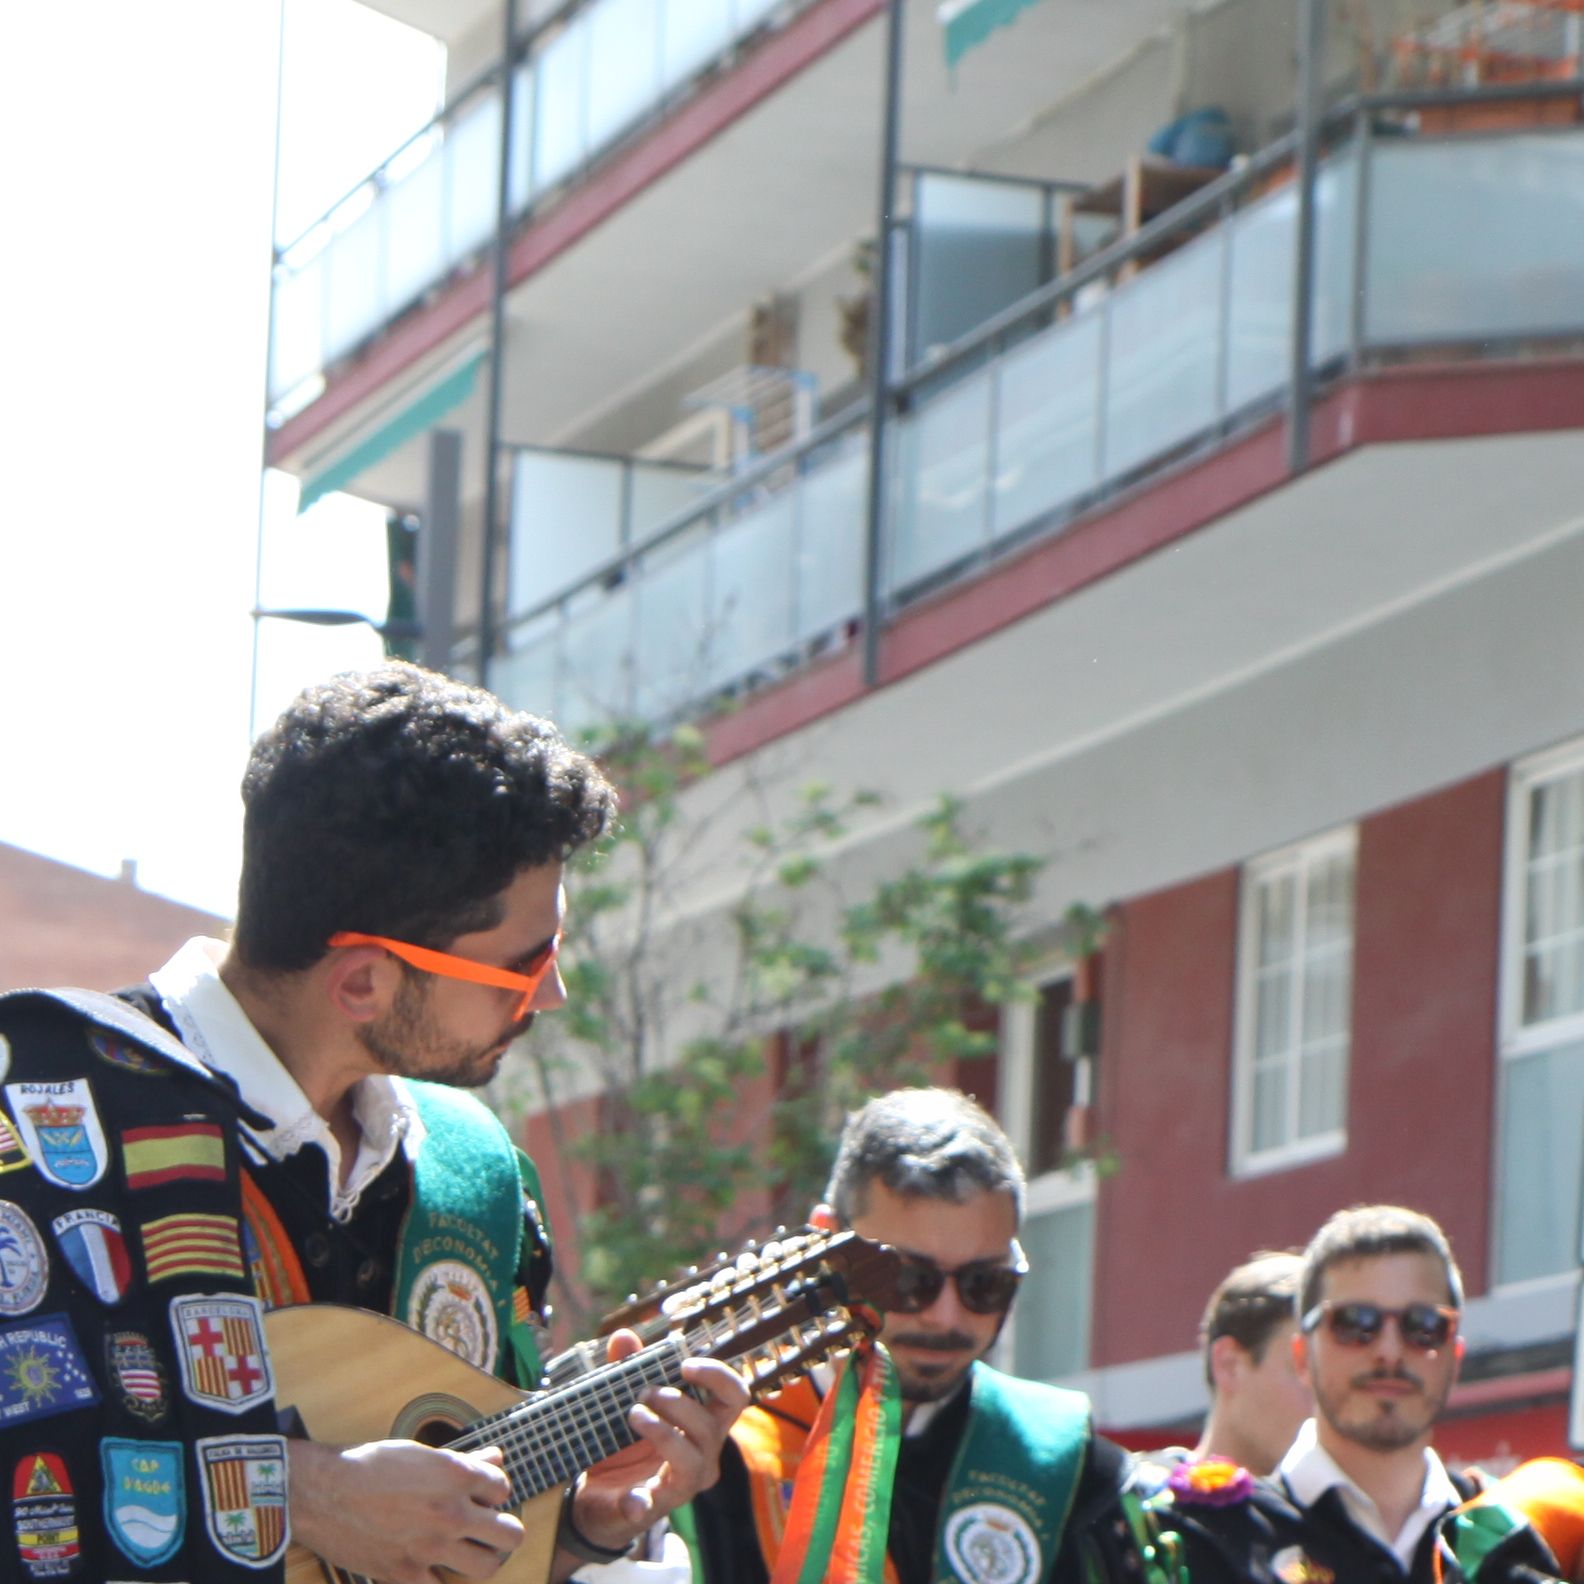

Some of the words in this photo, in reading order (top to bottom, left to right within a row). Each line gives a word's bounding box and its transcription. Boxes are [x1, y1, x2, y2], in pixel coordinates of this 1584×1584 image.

[20, 1083, 74, 1094] ROJALES
[55, 1210, 119, 1228] FRANCIA
[7, 1330, 68, 1350] REPUBLIC
[4, 1400, 30, 1417] WEST
[131, 1458, 160, 1473] CAP
[854, 1407, 887, 1513] COMERCIO
